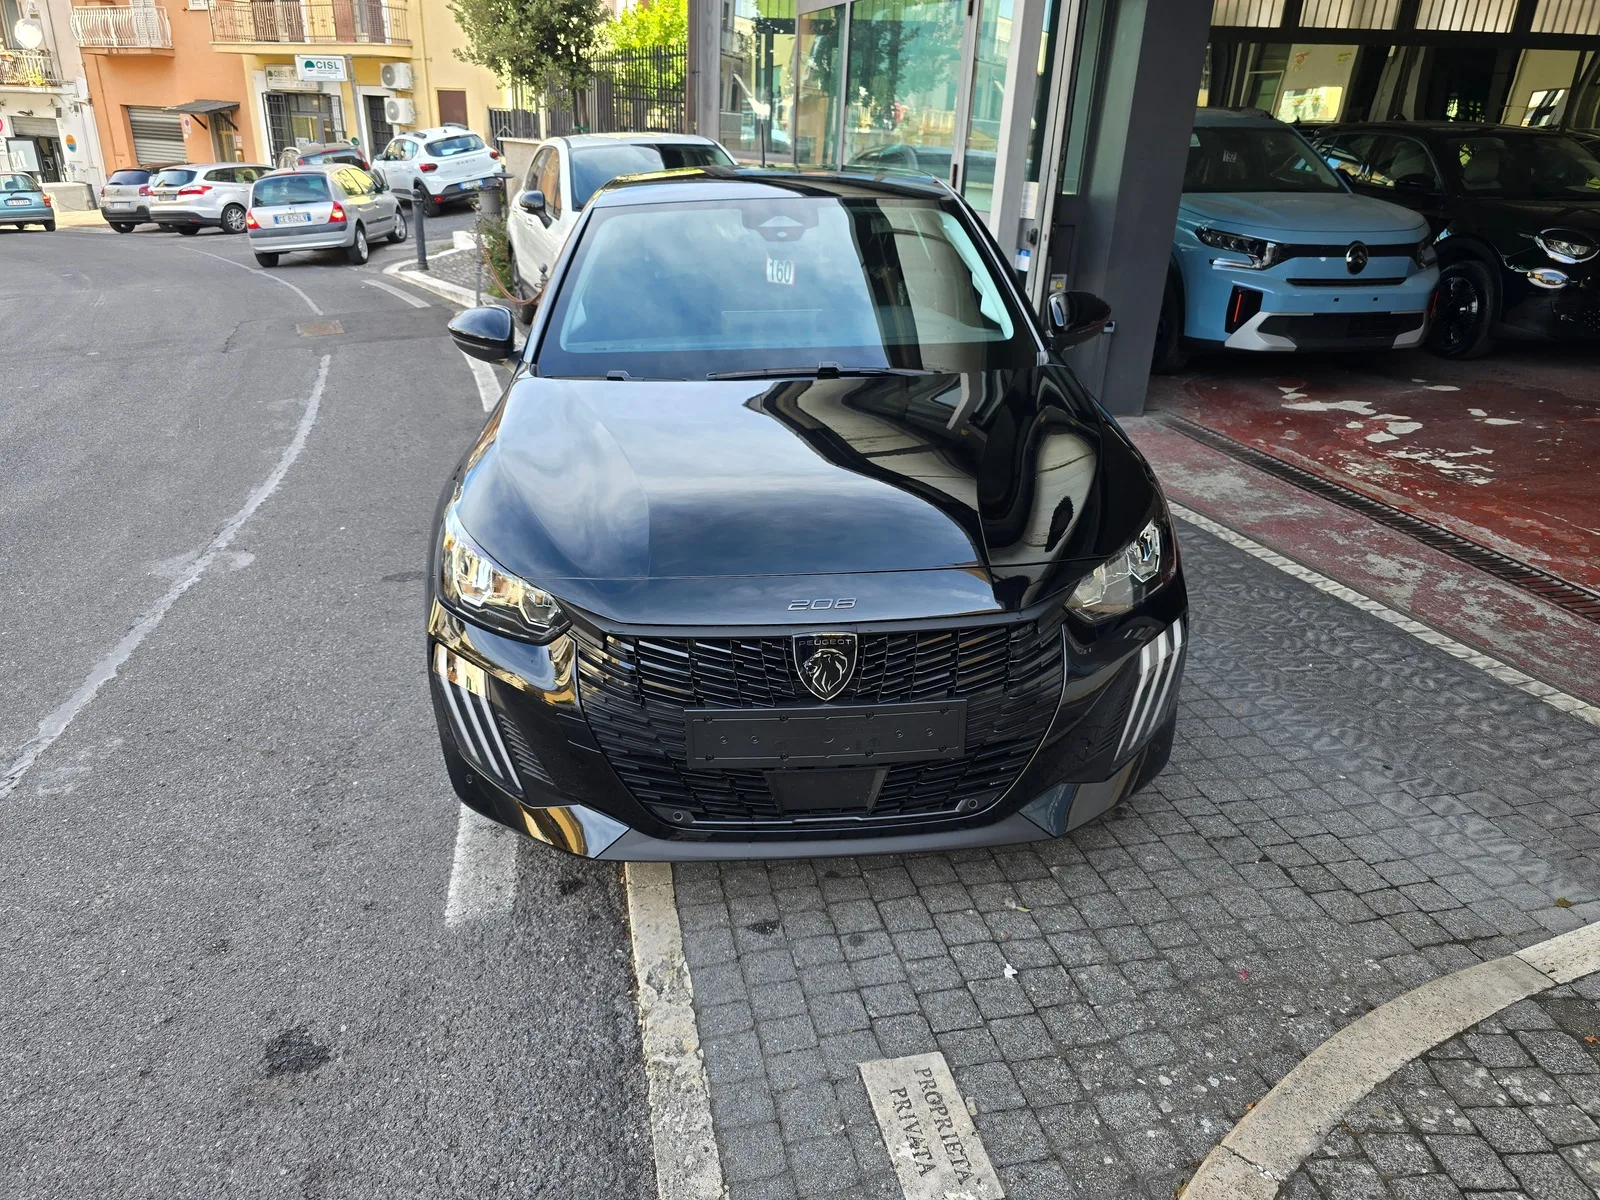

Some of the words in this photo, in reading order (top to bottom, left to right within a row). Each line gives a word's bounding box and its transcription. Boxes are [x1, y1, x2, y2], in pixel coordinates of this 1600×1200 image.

[316, 61, 340, 69] CISL
[769, 260, 791, 283] 160
[787, 597, 857, 611] 208
[798, 639, 852, 647] PEUGEOT
[889, 1087, 936, 1177] PRIVATA
